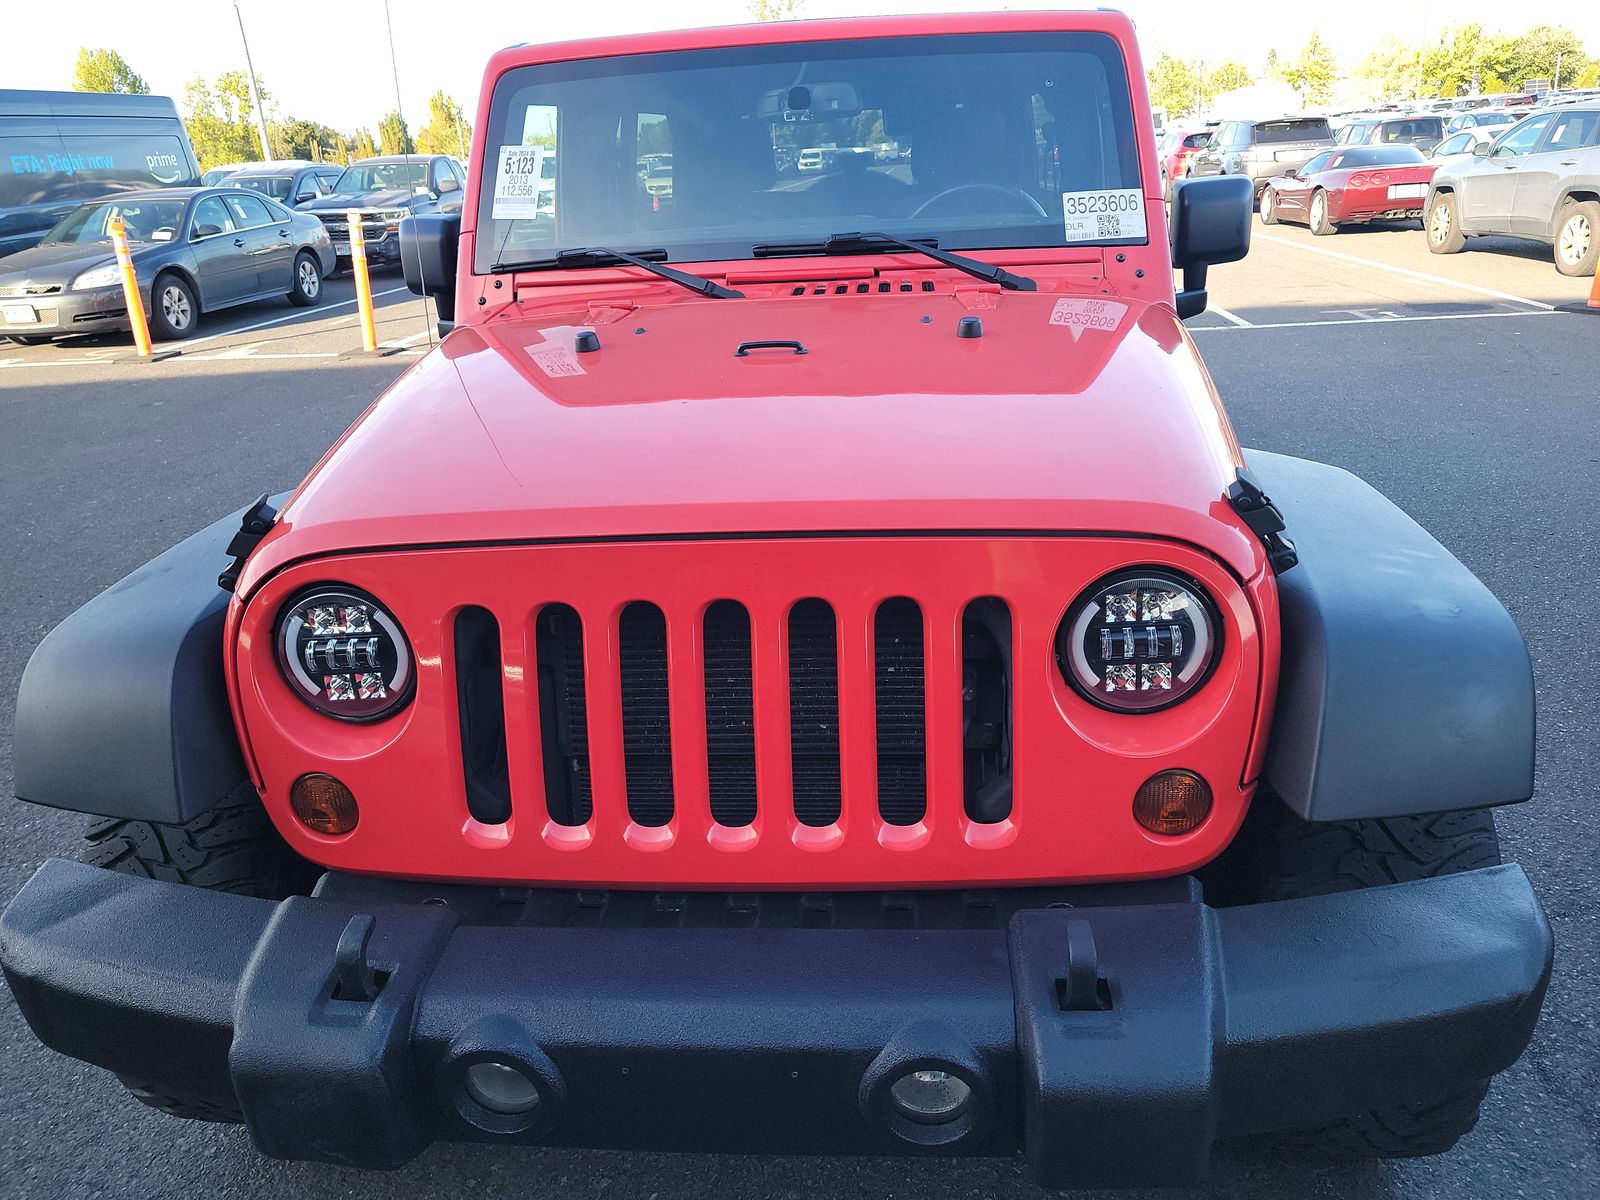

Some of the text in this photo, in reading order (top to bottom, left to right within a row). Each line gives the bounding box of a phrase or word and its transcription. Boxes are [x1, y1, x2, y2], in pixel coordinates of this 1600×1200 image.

[10, 152, 114, 177] ETA: Right now
[145, 151, 178, 171] prime
[505, 157, 534, 174] 5:123
[508, 175, 528, 185] 2013
[502, 185, 532, 196] 112,556
[1067, 194, 1138, 214] 3523606
[1065, 222, 1084, 231] DLR
